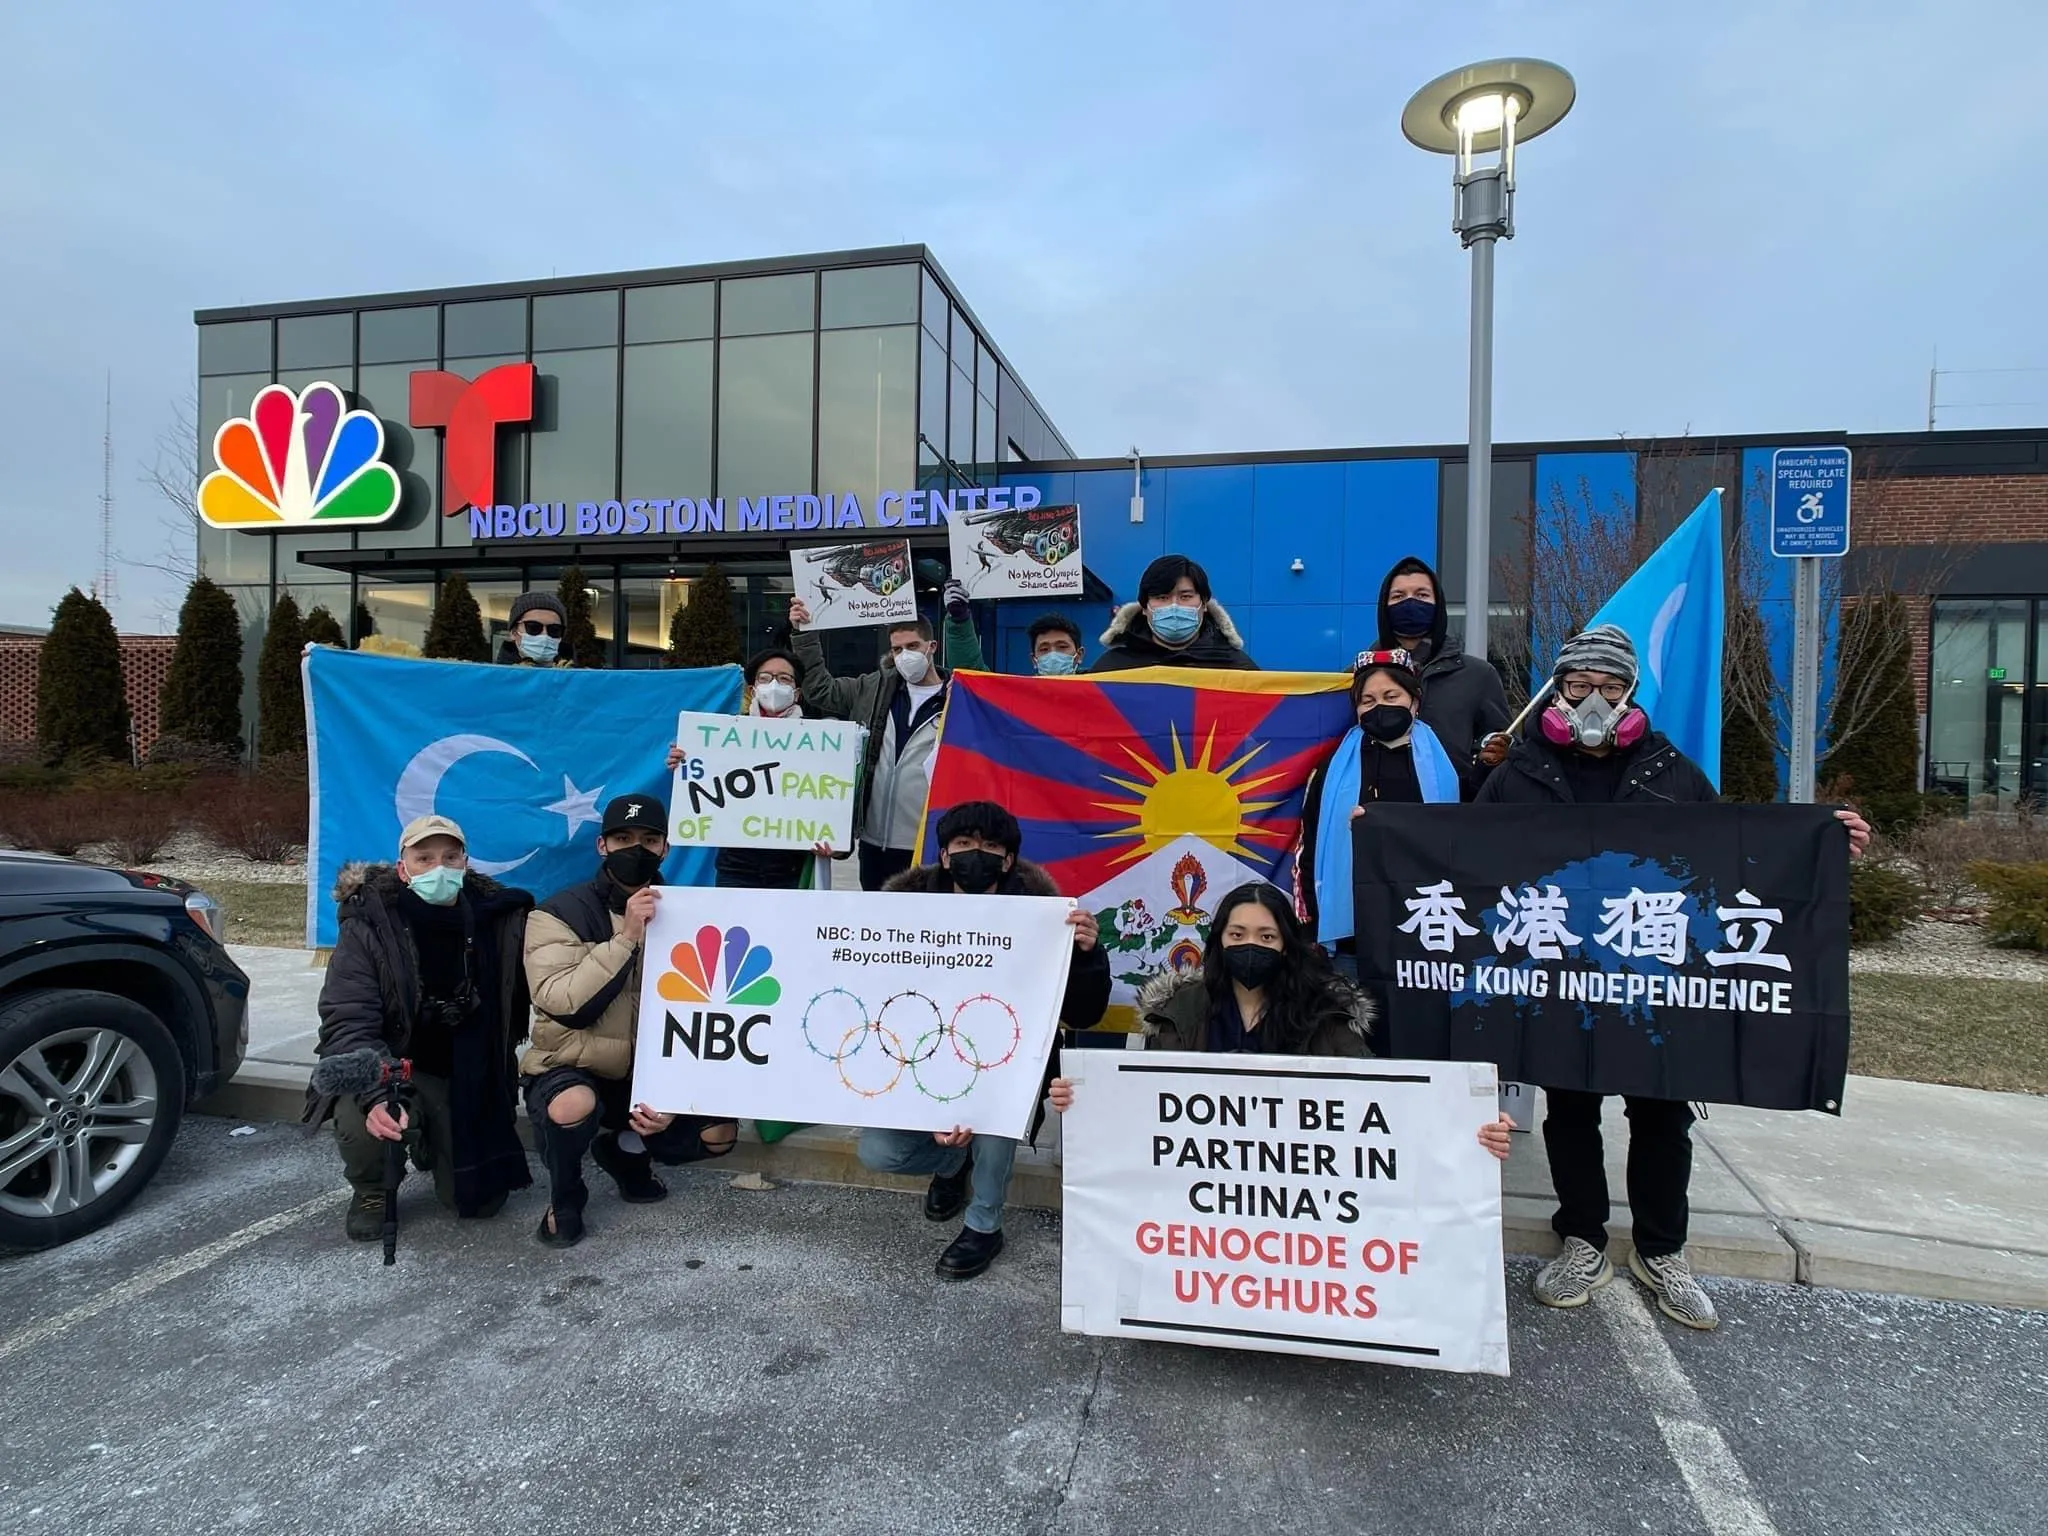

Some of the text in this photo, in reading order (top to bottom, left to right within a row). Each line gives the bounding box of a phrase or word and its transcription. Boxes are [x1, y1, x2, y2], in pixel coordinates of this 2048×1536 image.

[1778, 468, 1845, 479] SPECIAL PLATE
[1789, 480, 1833, 489] REQUIRED
[471, 486, 1041, 538] NBCU BOSTON MEDIA CENTER
[1008, 567, 1080, 581] No More Olympic
[1049, 580, 1078, 589] Games
[848, 597, 913, 610] No More Olympic
[697, 725, 842, 752] TAIWAN
[688, 761, 780, 814] NOT
[781, 772, 854, 800] PART
[678, 815, 836, 841] OF CHINA
[817, 926, 1012, 950] NBC: Do The Right Thing
[1397, 879, 1792, 972] 香港獨立
[832, 948, 993, 969] #BoycottBeijing2022
[1396, 960, 1792, 1014] HONG KONG INDEPENDENCE
[662, 1009, 771, 1065] NBC
[1159, 1092, 1391, 1134] DON'T BE A
[1153, 1135, 1397, 1180] PARTNER IN
[1189, 1181, 1360, 1224] CHINA'S
[1136, 1221, 1419, 1275] GENOCIDE OF
[1175, 1269, 1378, 1319] UYGHURS
